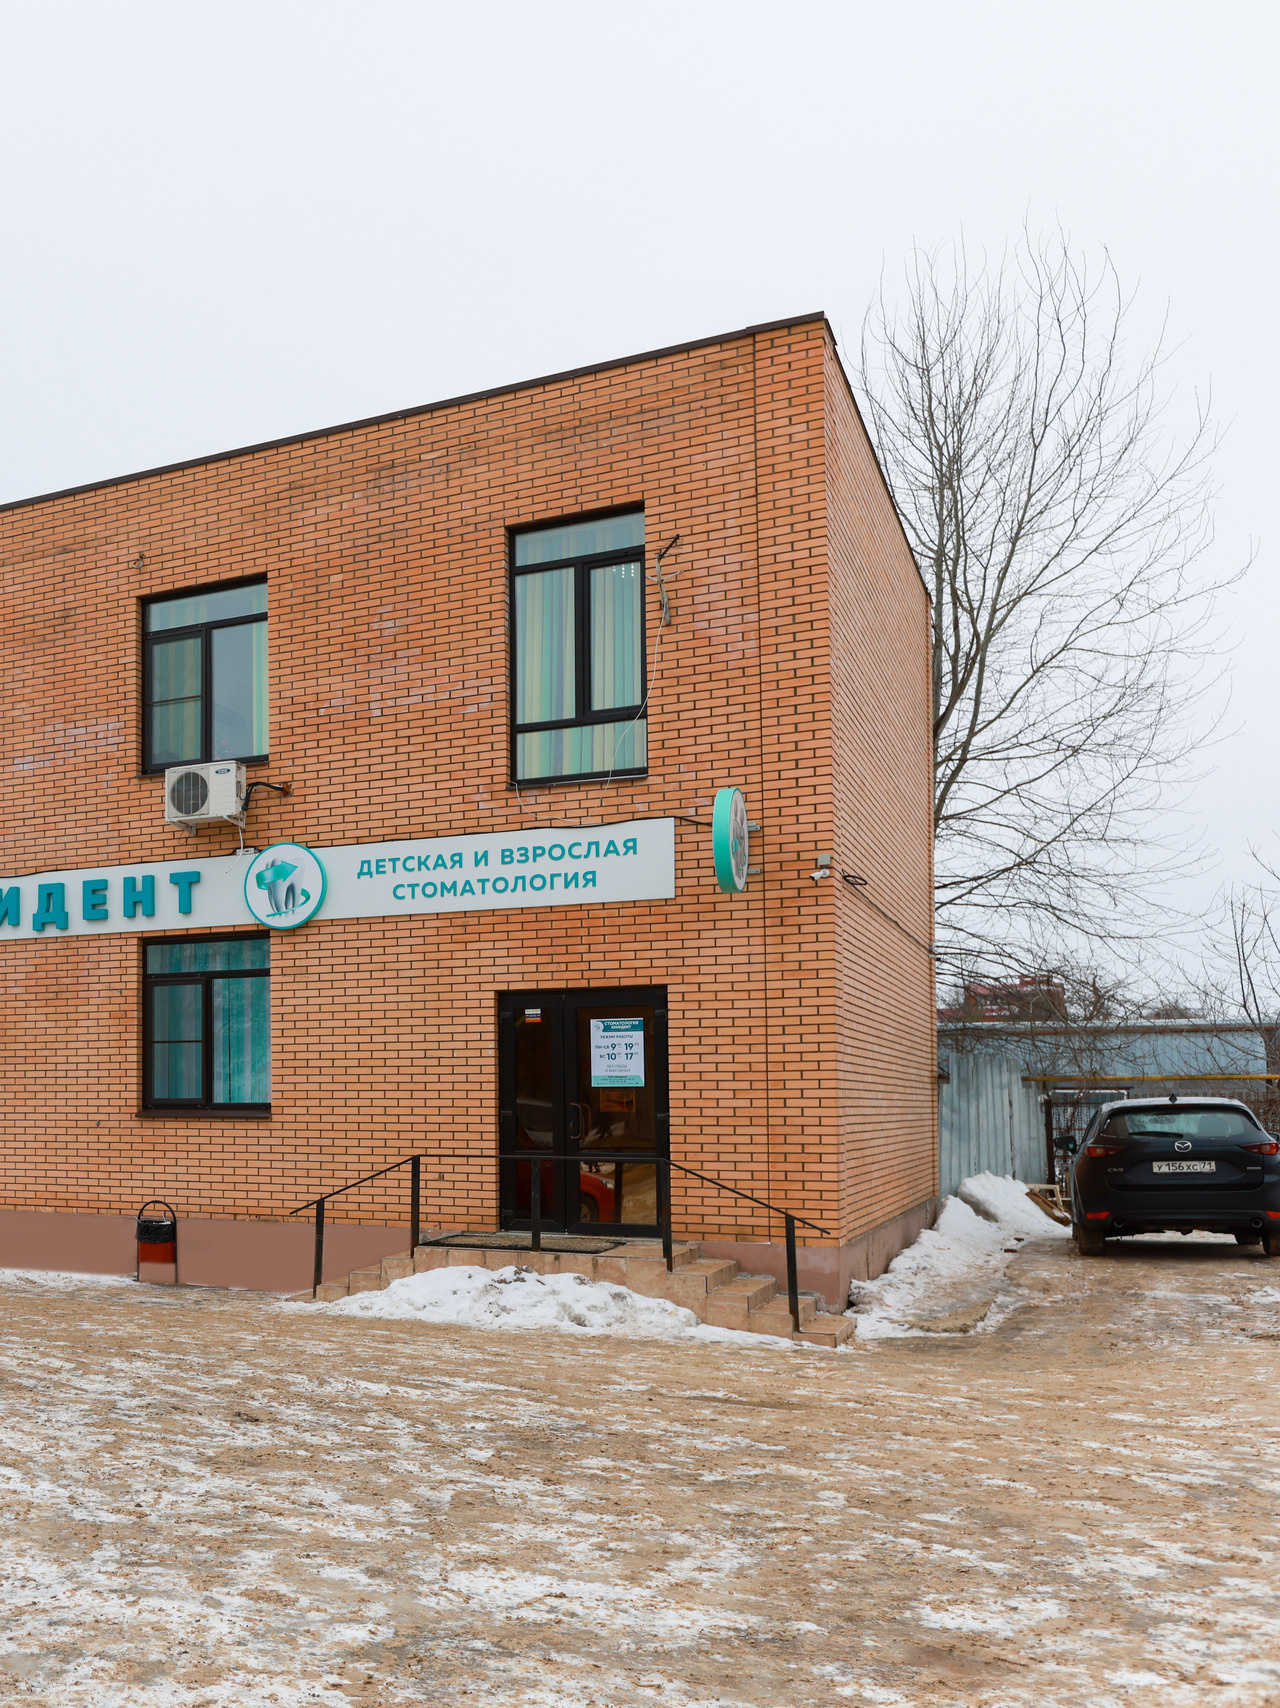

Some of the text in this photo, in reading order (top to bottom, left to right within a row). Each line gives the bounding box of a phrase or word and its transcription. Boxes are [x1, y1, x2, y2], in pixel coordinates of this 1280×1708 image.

[356, 837, 638, 880] ДЕТСКАЯ И ВЗРОСЛАЯ
[392, 870, 597, 900] СТОМАТОЛОГИЯ
